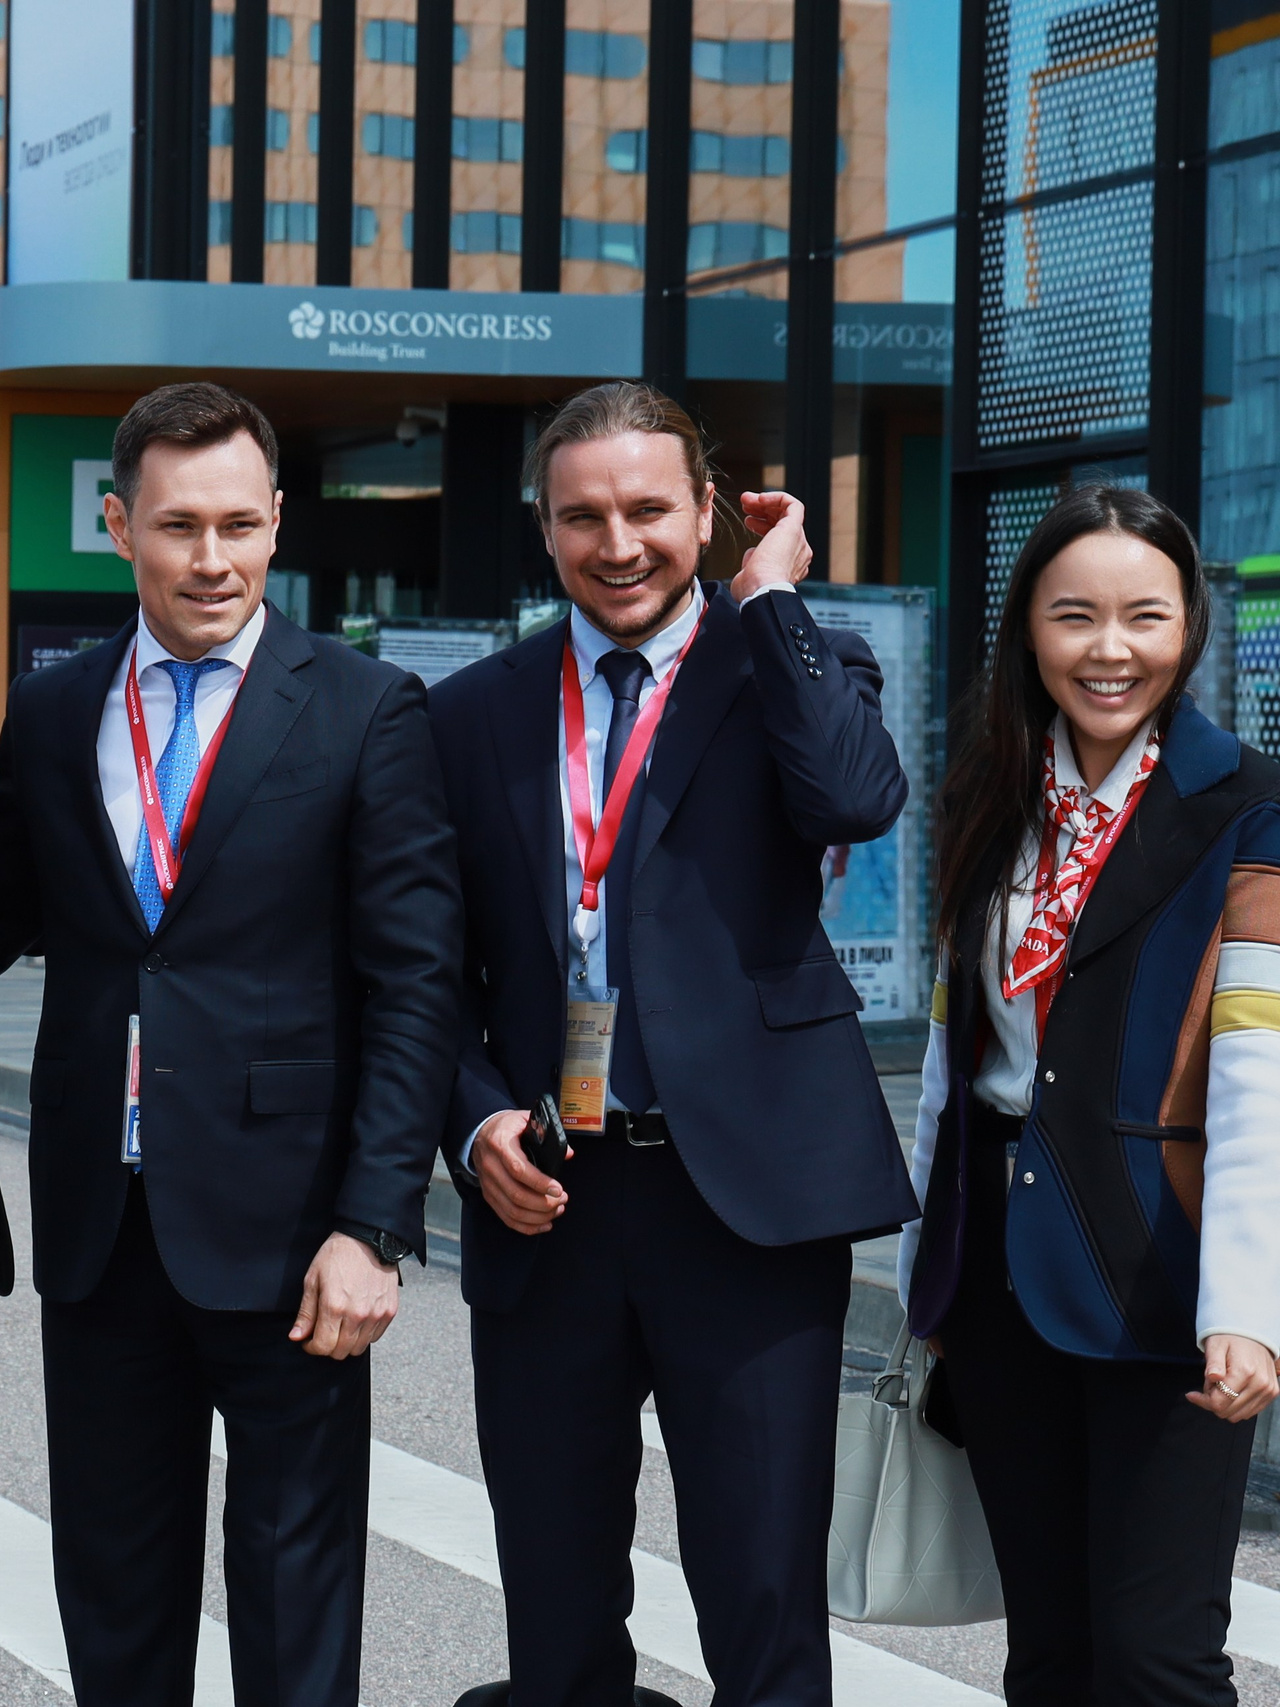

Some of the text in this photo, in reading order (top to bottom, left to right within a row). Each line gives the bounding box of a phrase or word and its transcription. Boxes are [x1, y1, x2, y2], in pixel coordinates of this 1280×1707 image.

[328, 309, 553, 341] ROSCONGRESS
[328, 342, 426, 362] Building Trust
[141, 755, 153, 798] ROSCONGRESS
[1020, 936, 1050, 956] RADA
